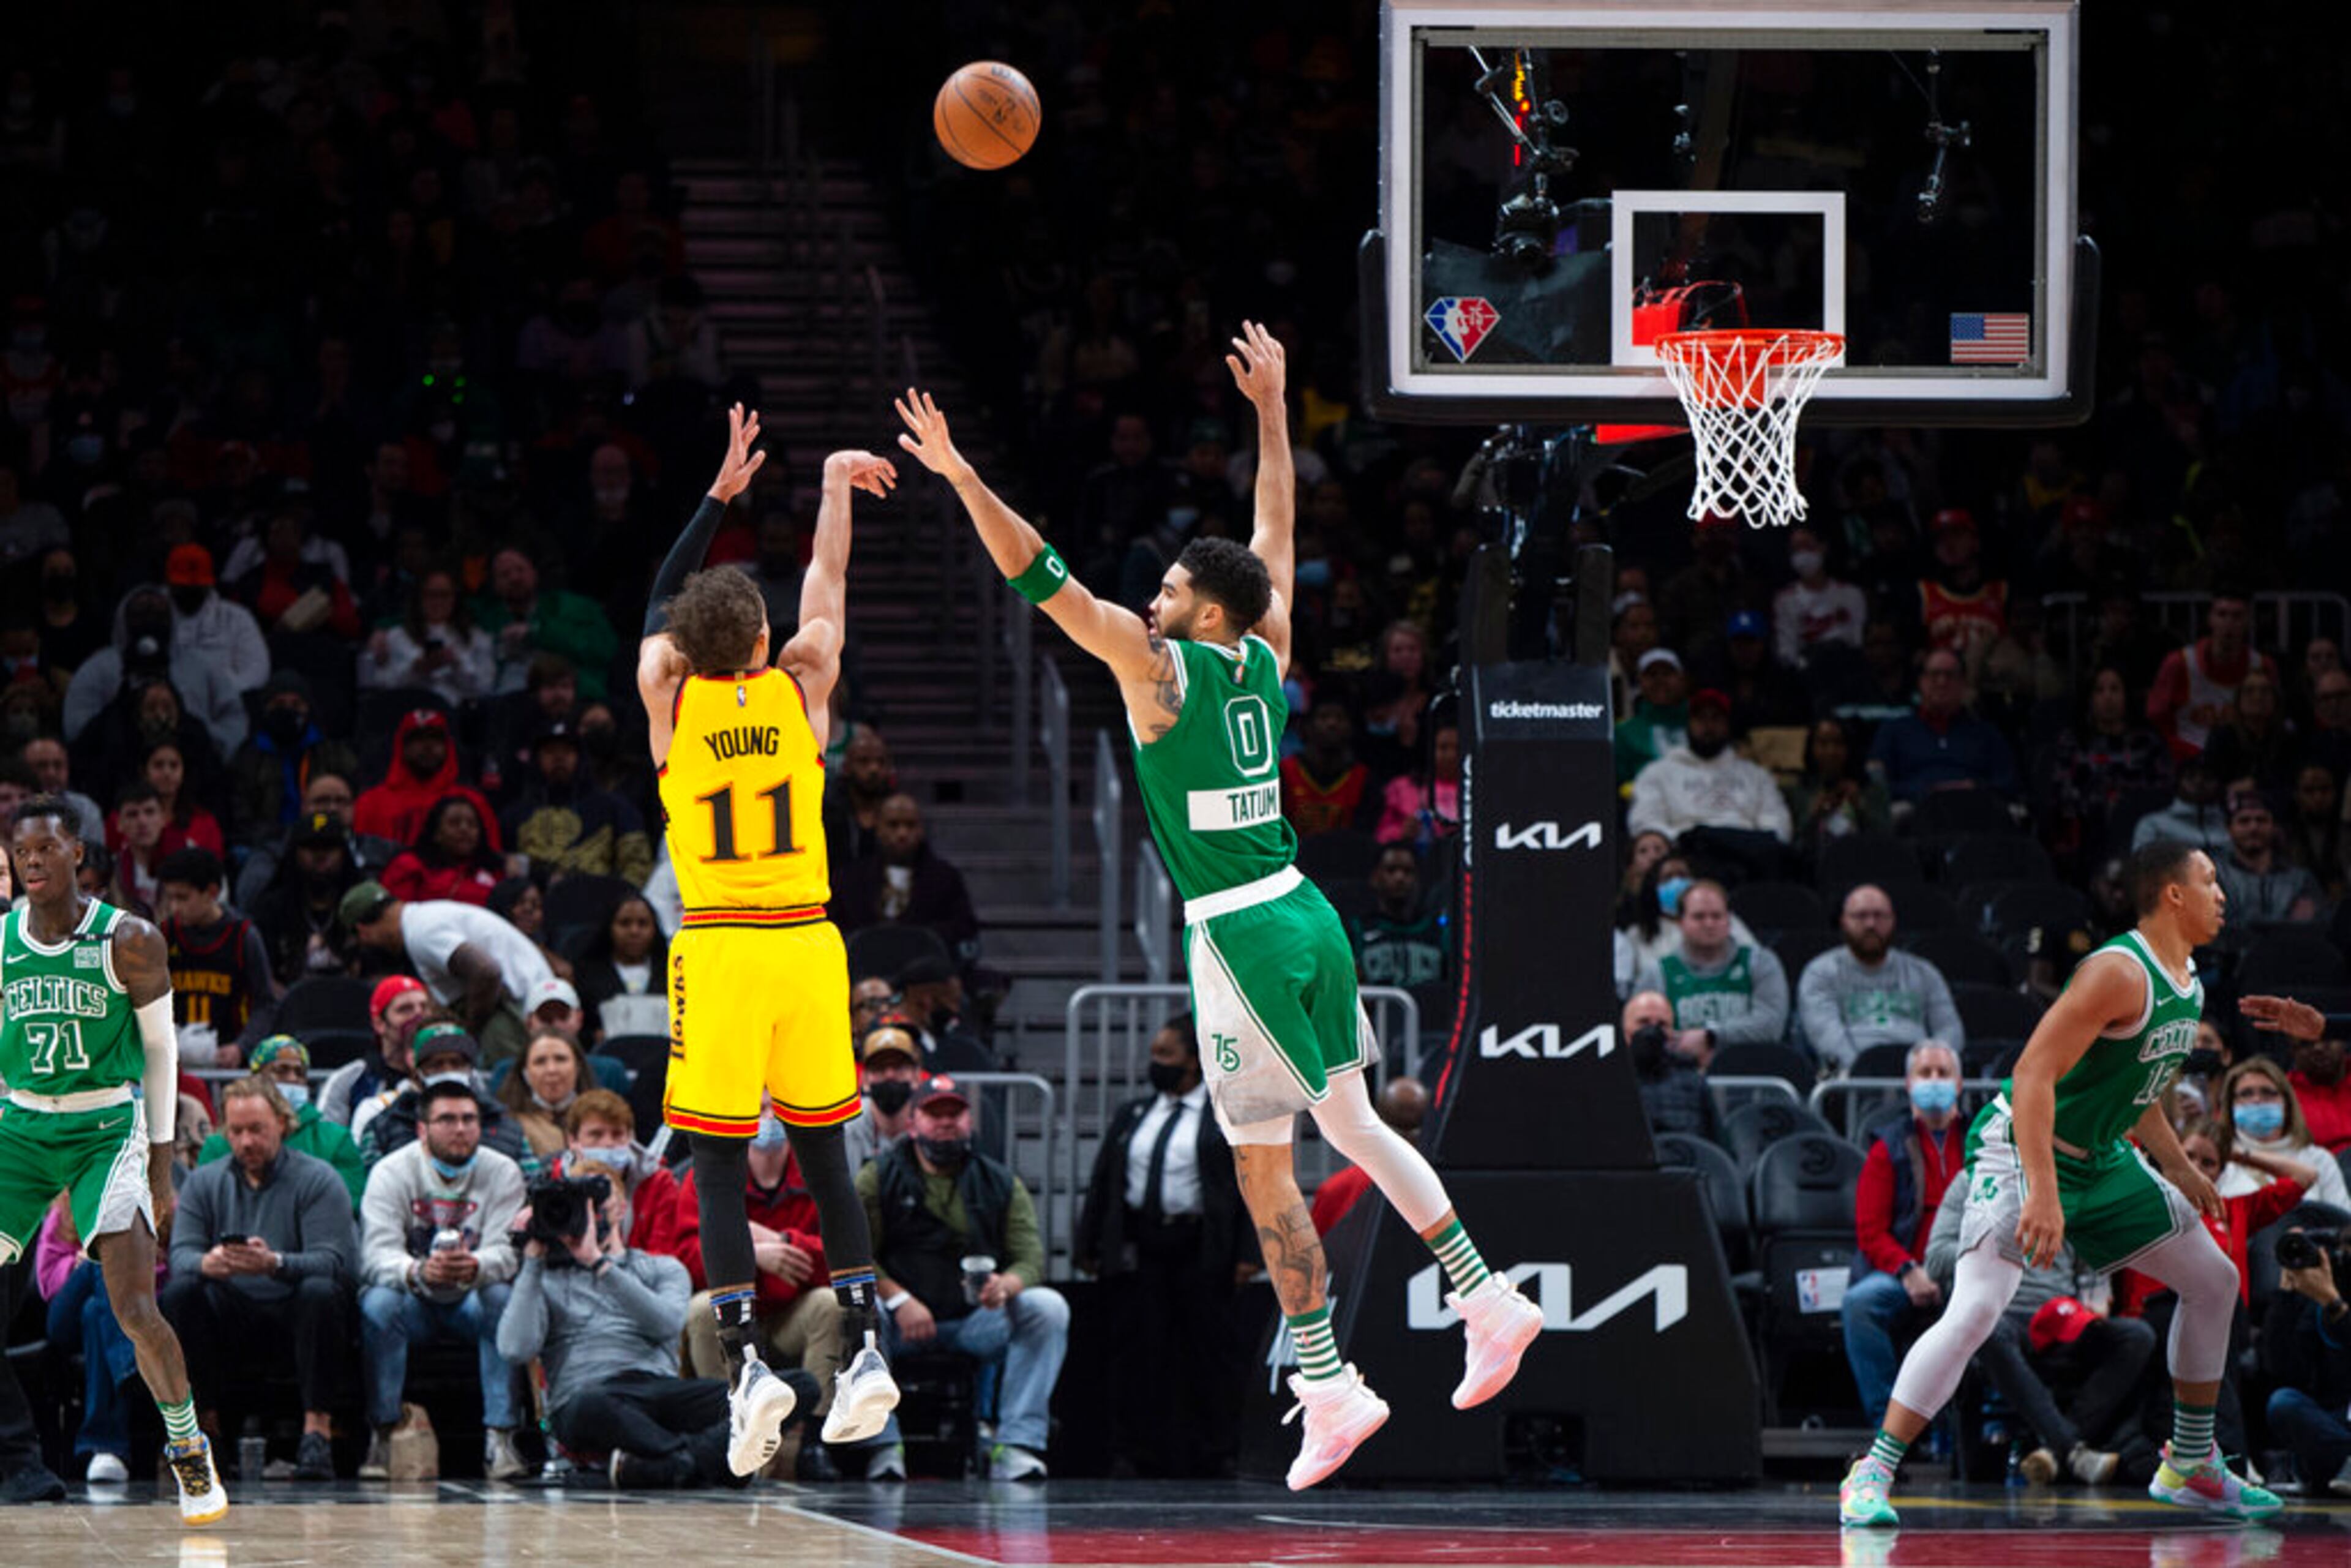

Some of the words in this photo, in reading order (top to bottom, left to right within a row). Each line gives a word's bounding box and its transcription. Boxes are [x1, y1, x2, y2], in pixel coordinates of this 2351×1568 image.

[1046, 555, 1064, 579] 0
[1490, 700, 1604, 719] ticketmaster
[703, 725, 780, 762] YOUNG
[1224, 694, 1273, 778] 0
[694, 773, 806, 865] 11
[1227, 786, 1277, 823] TATUM
[1495, 821, 1602, 850] KIA
[4, 975, 108, 1022] CELTICS
[25, 1019, 90, 1075] 71
[1212, 1033, 1240, 1072] 75
[1480, 1024, 1616, 1059] KIA
